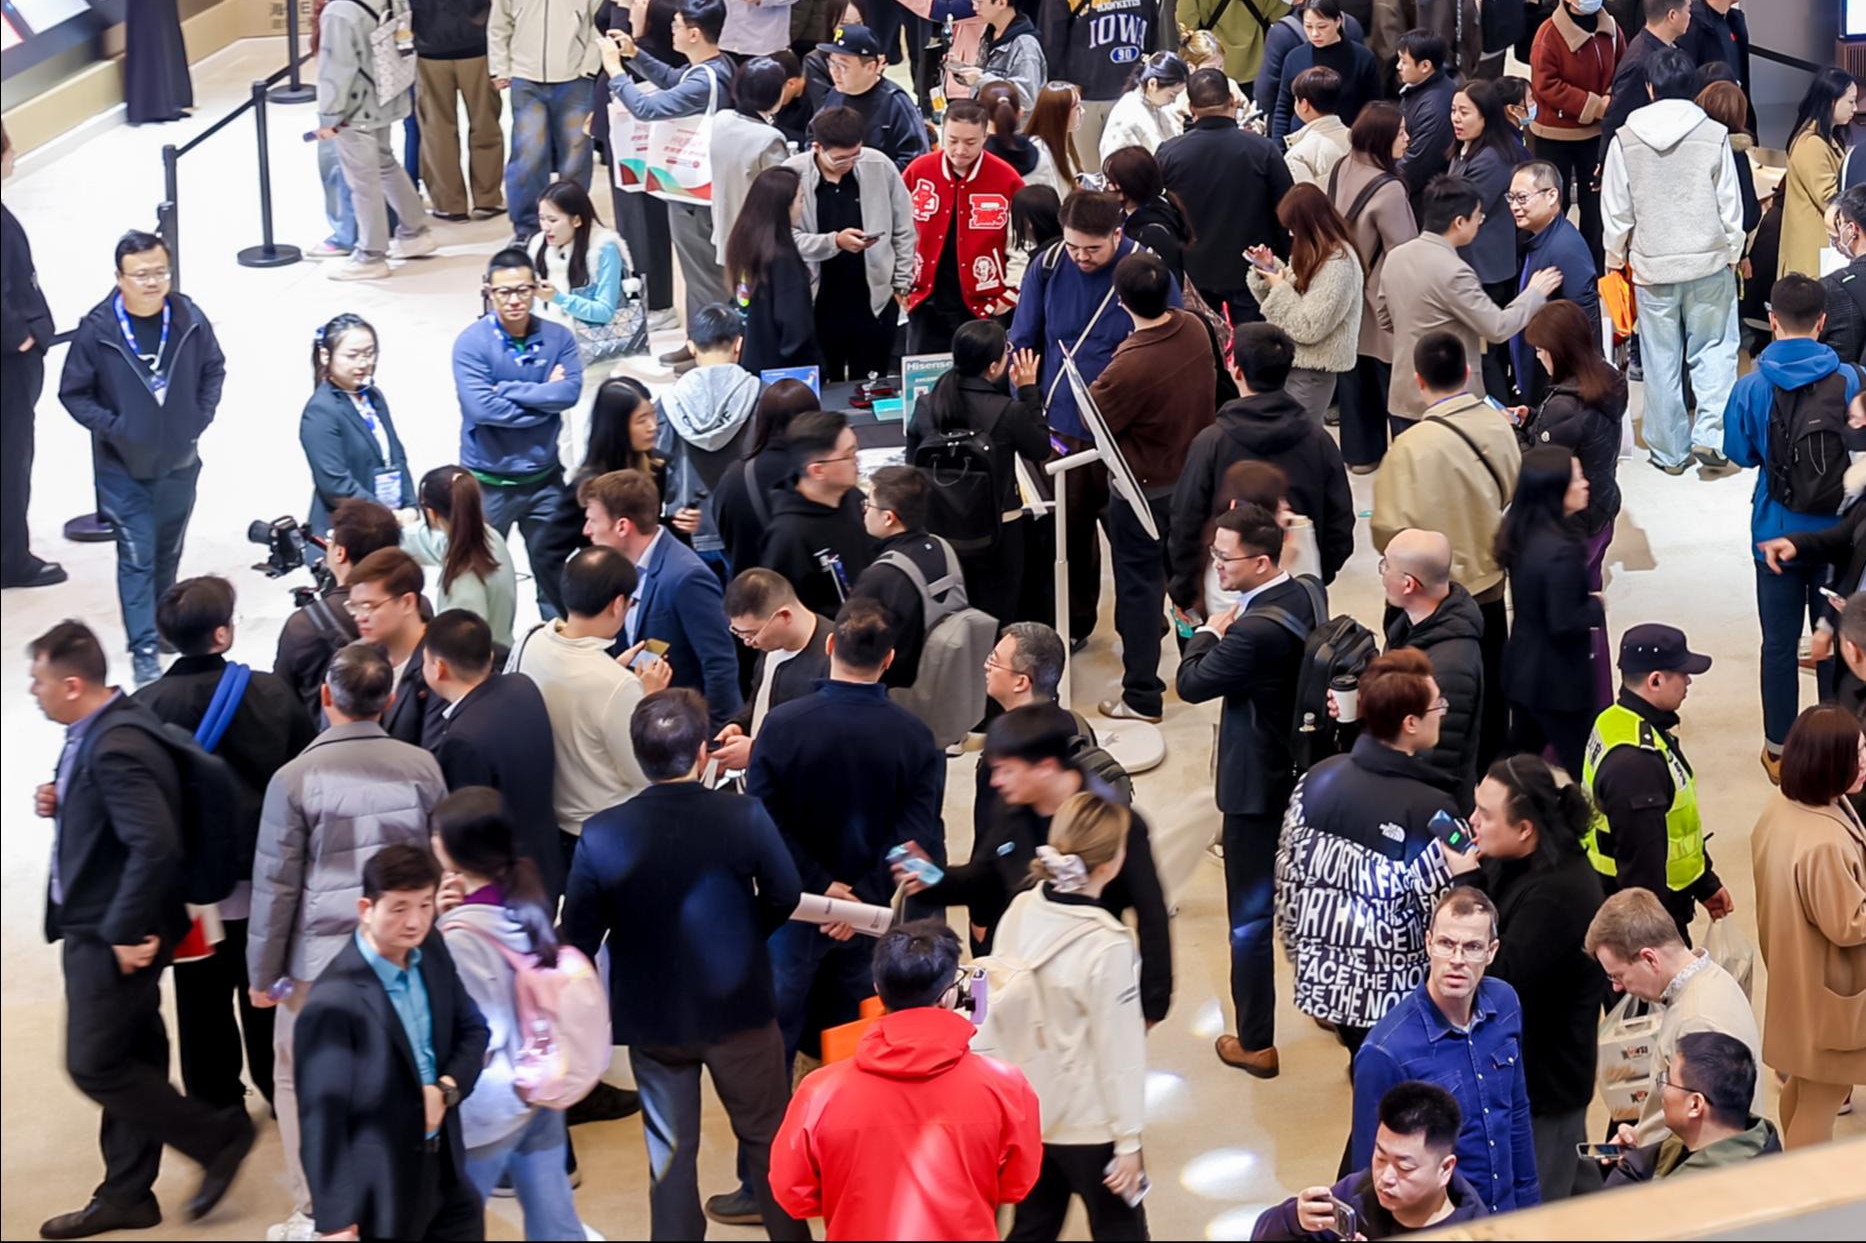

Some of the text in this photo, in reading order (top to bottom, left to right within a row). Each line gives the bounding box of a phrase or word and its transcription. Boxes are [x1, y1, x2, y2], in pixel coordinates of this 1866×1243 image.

[1308, 836, 1373, 897] NORTH
[1298, 953, 1350, 985] FACE
[1353, 968, 1388, 991] THE
